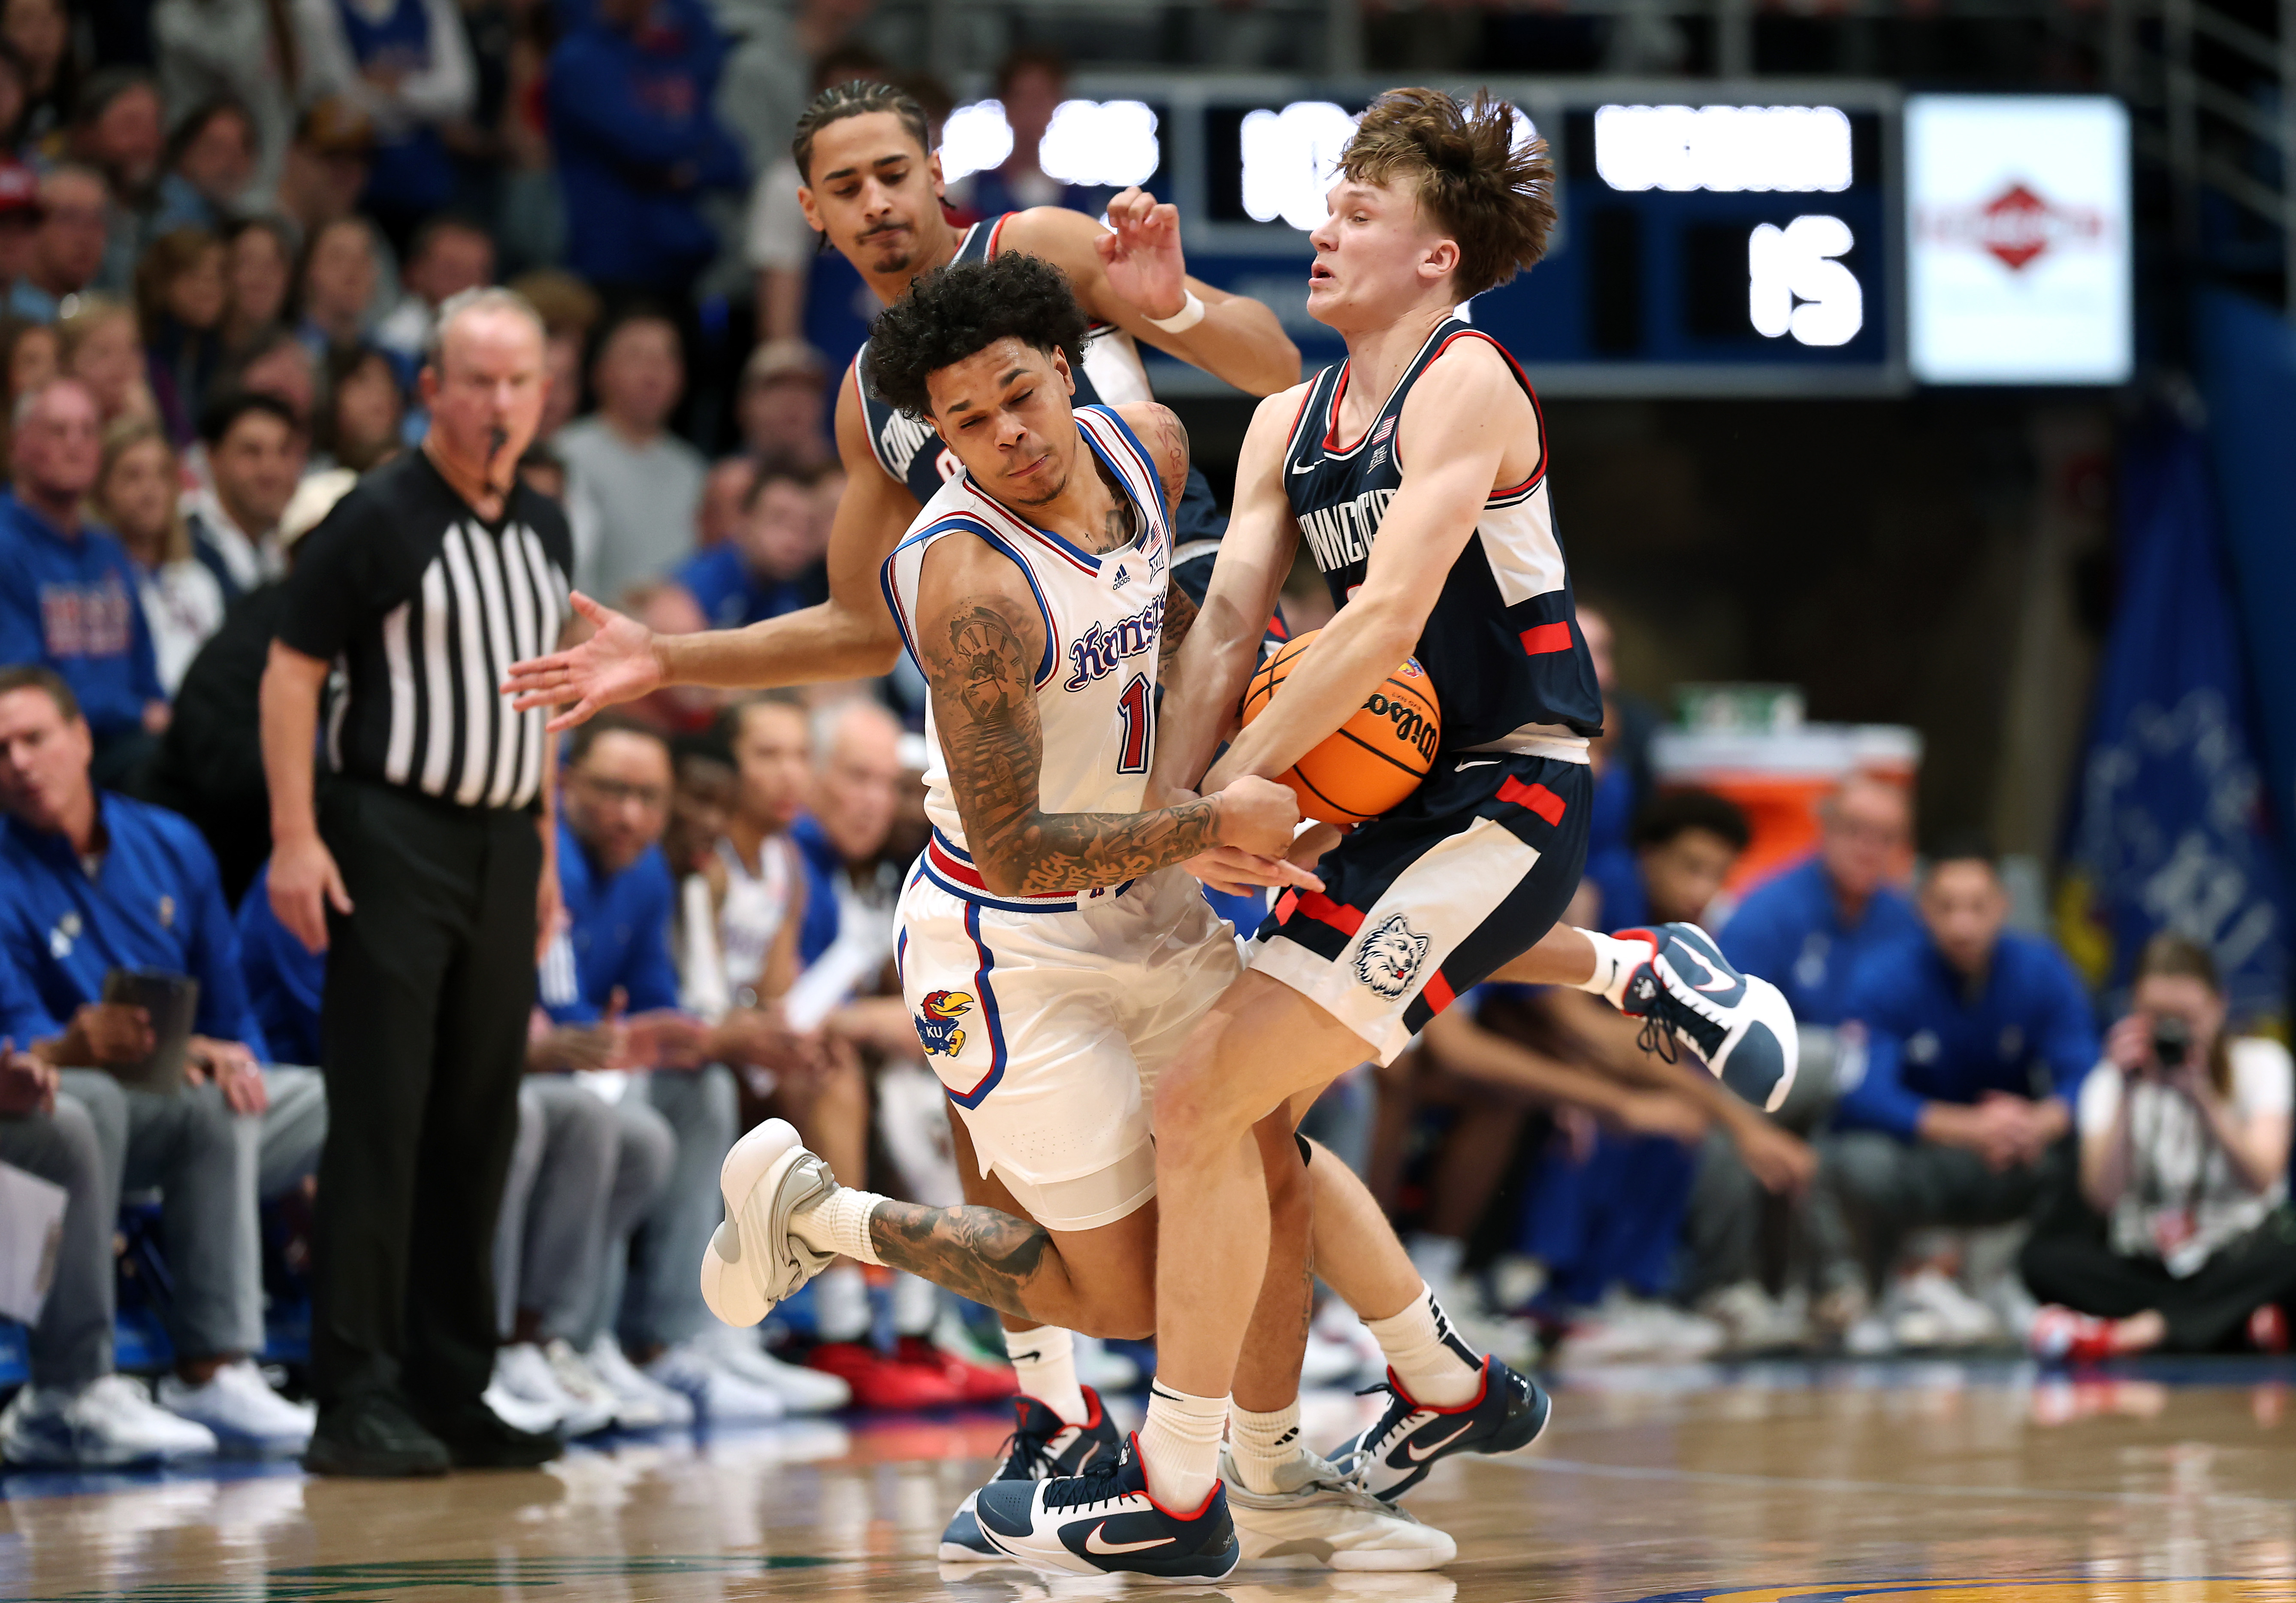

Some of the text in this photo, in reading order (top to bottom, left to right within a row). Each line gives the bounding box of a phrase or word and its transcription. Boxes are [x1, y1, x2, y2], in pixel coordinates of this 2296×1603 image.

[1112, 575, 1131, 590] addas
[1117, 671, 1151, 774] 1
[1361, 693, 1437, 764] Wilso
[925, 1026, 943, 1038] KU
